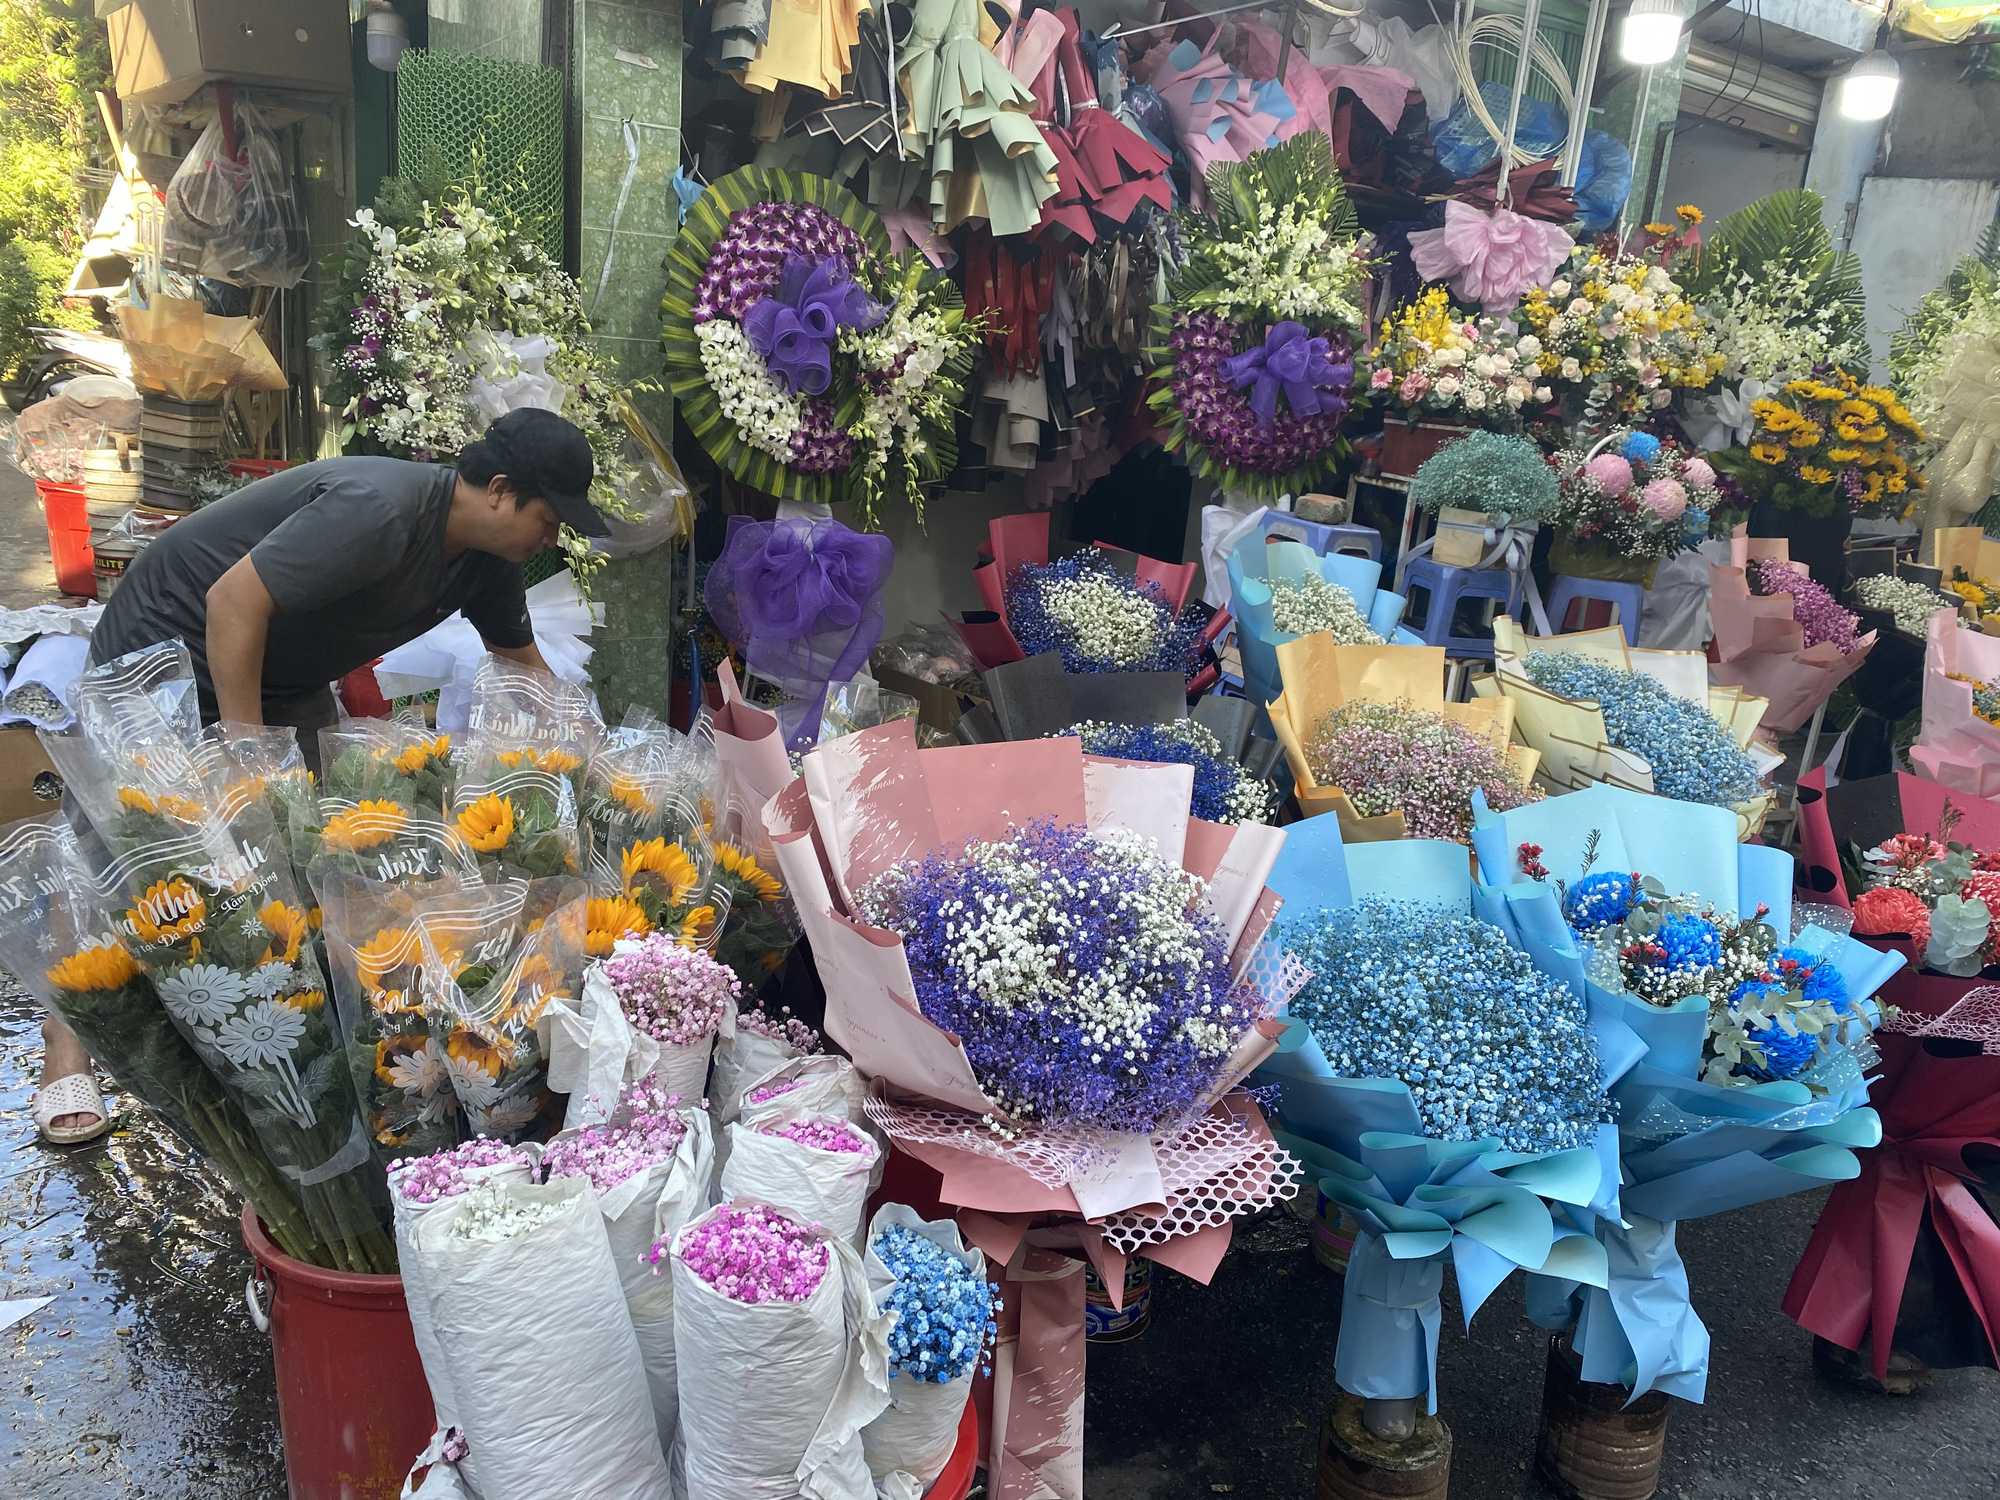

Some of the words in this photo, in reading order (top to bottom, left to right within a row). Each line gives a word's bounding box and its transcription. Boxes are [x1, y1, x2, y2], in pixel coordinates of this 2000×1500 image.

[586, 793, 627, 827] Hoa
[138, 882, 204, 926] Nhà
[140, 942, 157, 953] tại
[157, 930, 182, 947] Đà
[183, 917, 207, 934] Lạt
[220, 895, 247, 913] Lâm
[248, 871, 279, 896] Đồng
